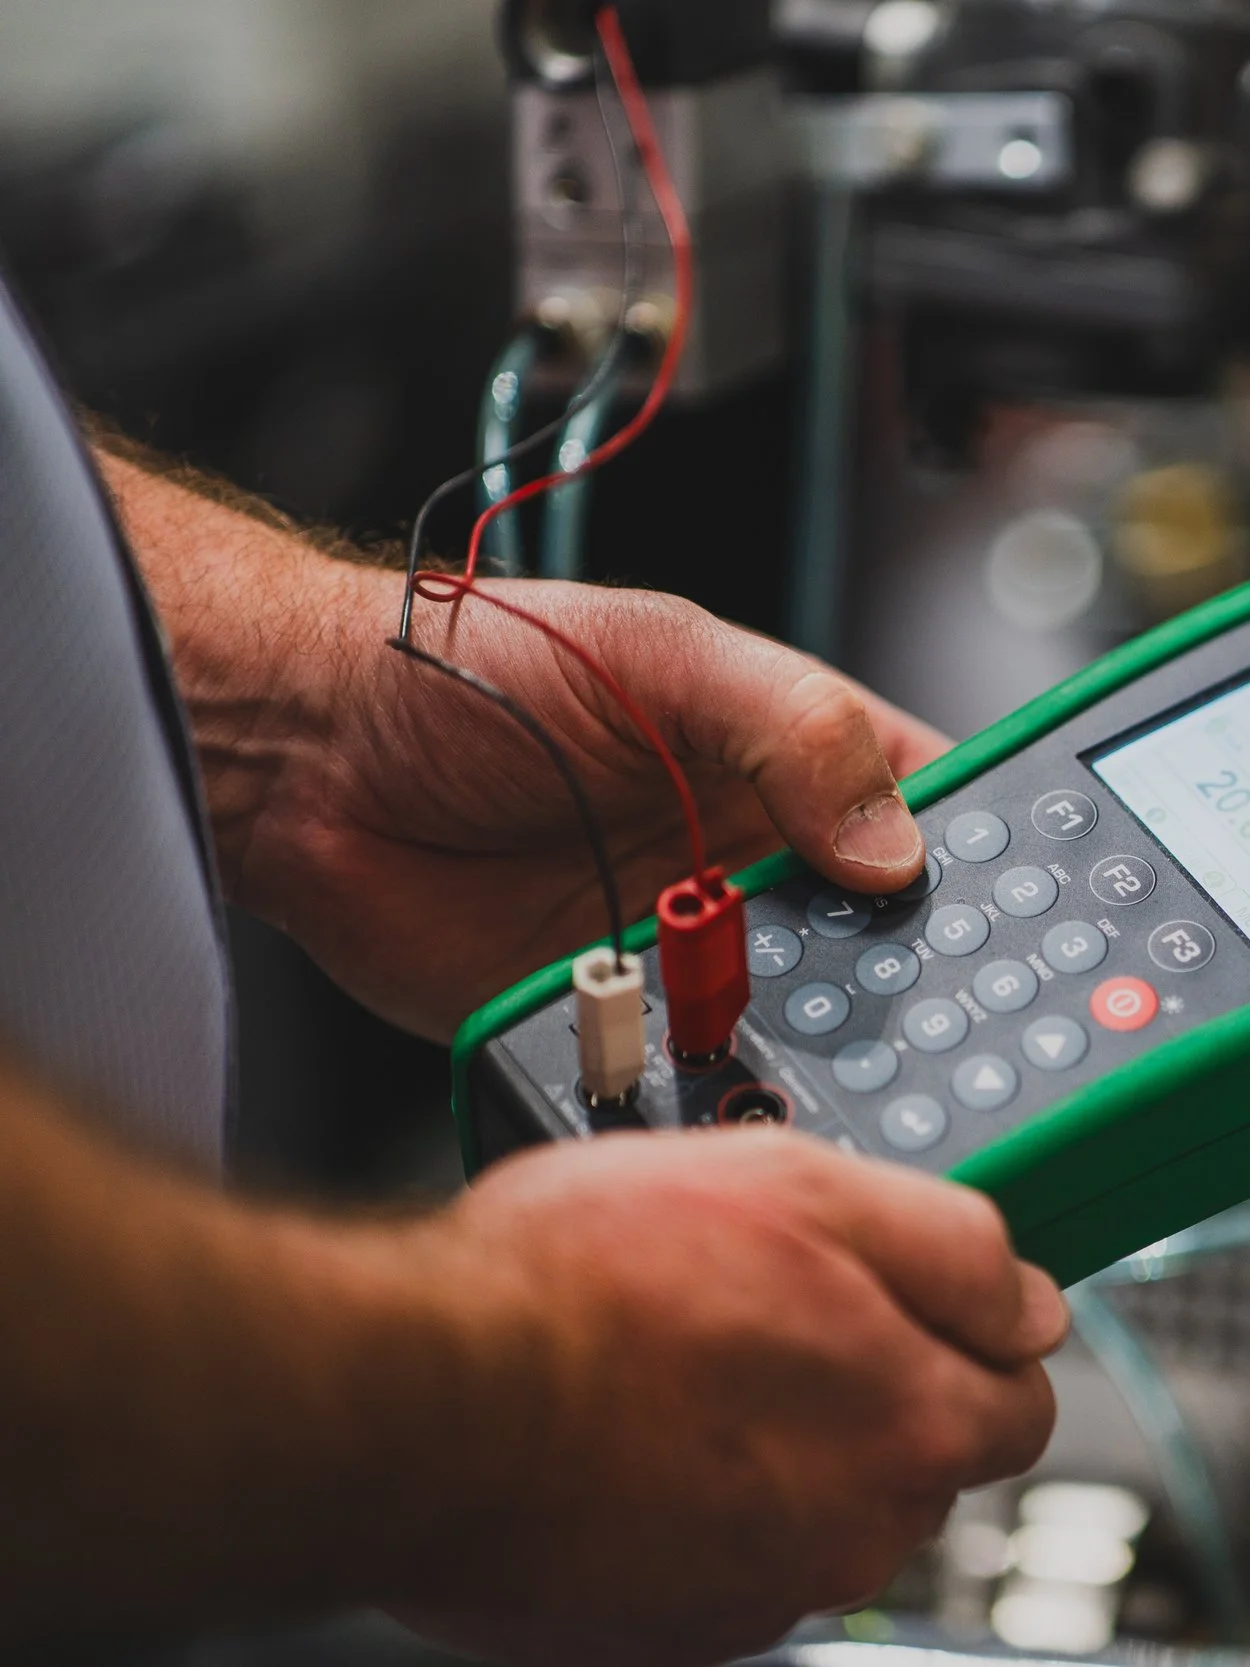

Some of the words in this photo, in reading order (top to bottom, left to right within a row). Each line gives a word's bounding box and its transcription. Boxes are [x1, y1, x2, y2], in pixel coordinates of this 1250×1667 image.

[1046, 800, 1084, 831] F1
[966, 828, 989, 845] 1
[932, 847, 954, 867] GHI
[1047, 863, 1071, 885] ABC
[1103, 864, 1141, 897] F2
[1011, 881, 1039, 903] 2
[826, 901, 854, 917] 7
[980, 903, 1001, 922] JKL
[944, 918, 972, 940] 5
[1097, 918, 1120, 938] DEF
[911, 938, 934, 961] TUV
[1061, 936, 1088, 958] 3
[1161, 929, 1201, 963] F3
[874, 957, 901, 979] 8
[1026, 953, 1054, 981] MNO
[992, 974, 1020, 997] 6
[803, 996, 832, 1018] 0
[955, 989, 988, 1024] WXYZ
[921, 1013, 950, 1036] 9
